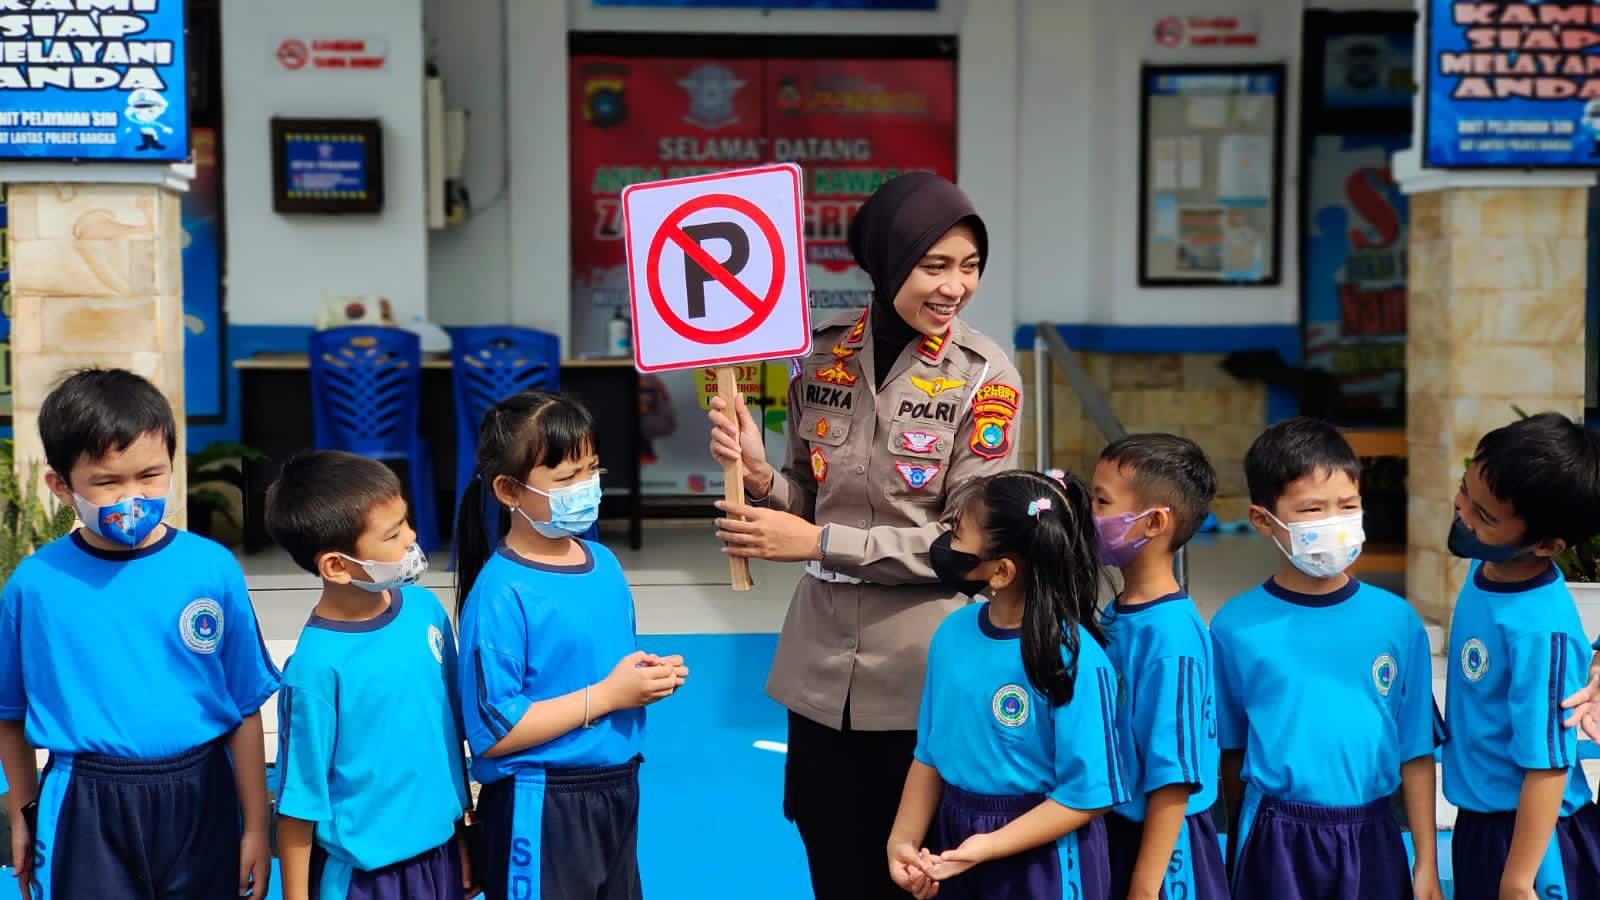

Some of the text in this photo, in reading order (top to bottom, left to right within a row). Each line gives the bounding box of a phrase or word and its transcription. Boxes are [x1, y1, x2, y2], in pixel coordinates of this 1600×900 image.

[0, 14, 147, 37] SIAP
[1466, 28, 1600, 49] SIAP
[0, 41, 172, 64] ELAYANI
[1441, 52, 1600, 75] MELAYAN
[0, 66, 166, 89] ANDA
[1453, 77, 1600, 99] ANDA
[775, 138, 870, 161] DATANG
[682, 221, 750, 320] P
[704, 365, 758, 382] SOP
[806, 384, 853, 410] RIZKA
[898, 401, 958, 424] POLRI
